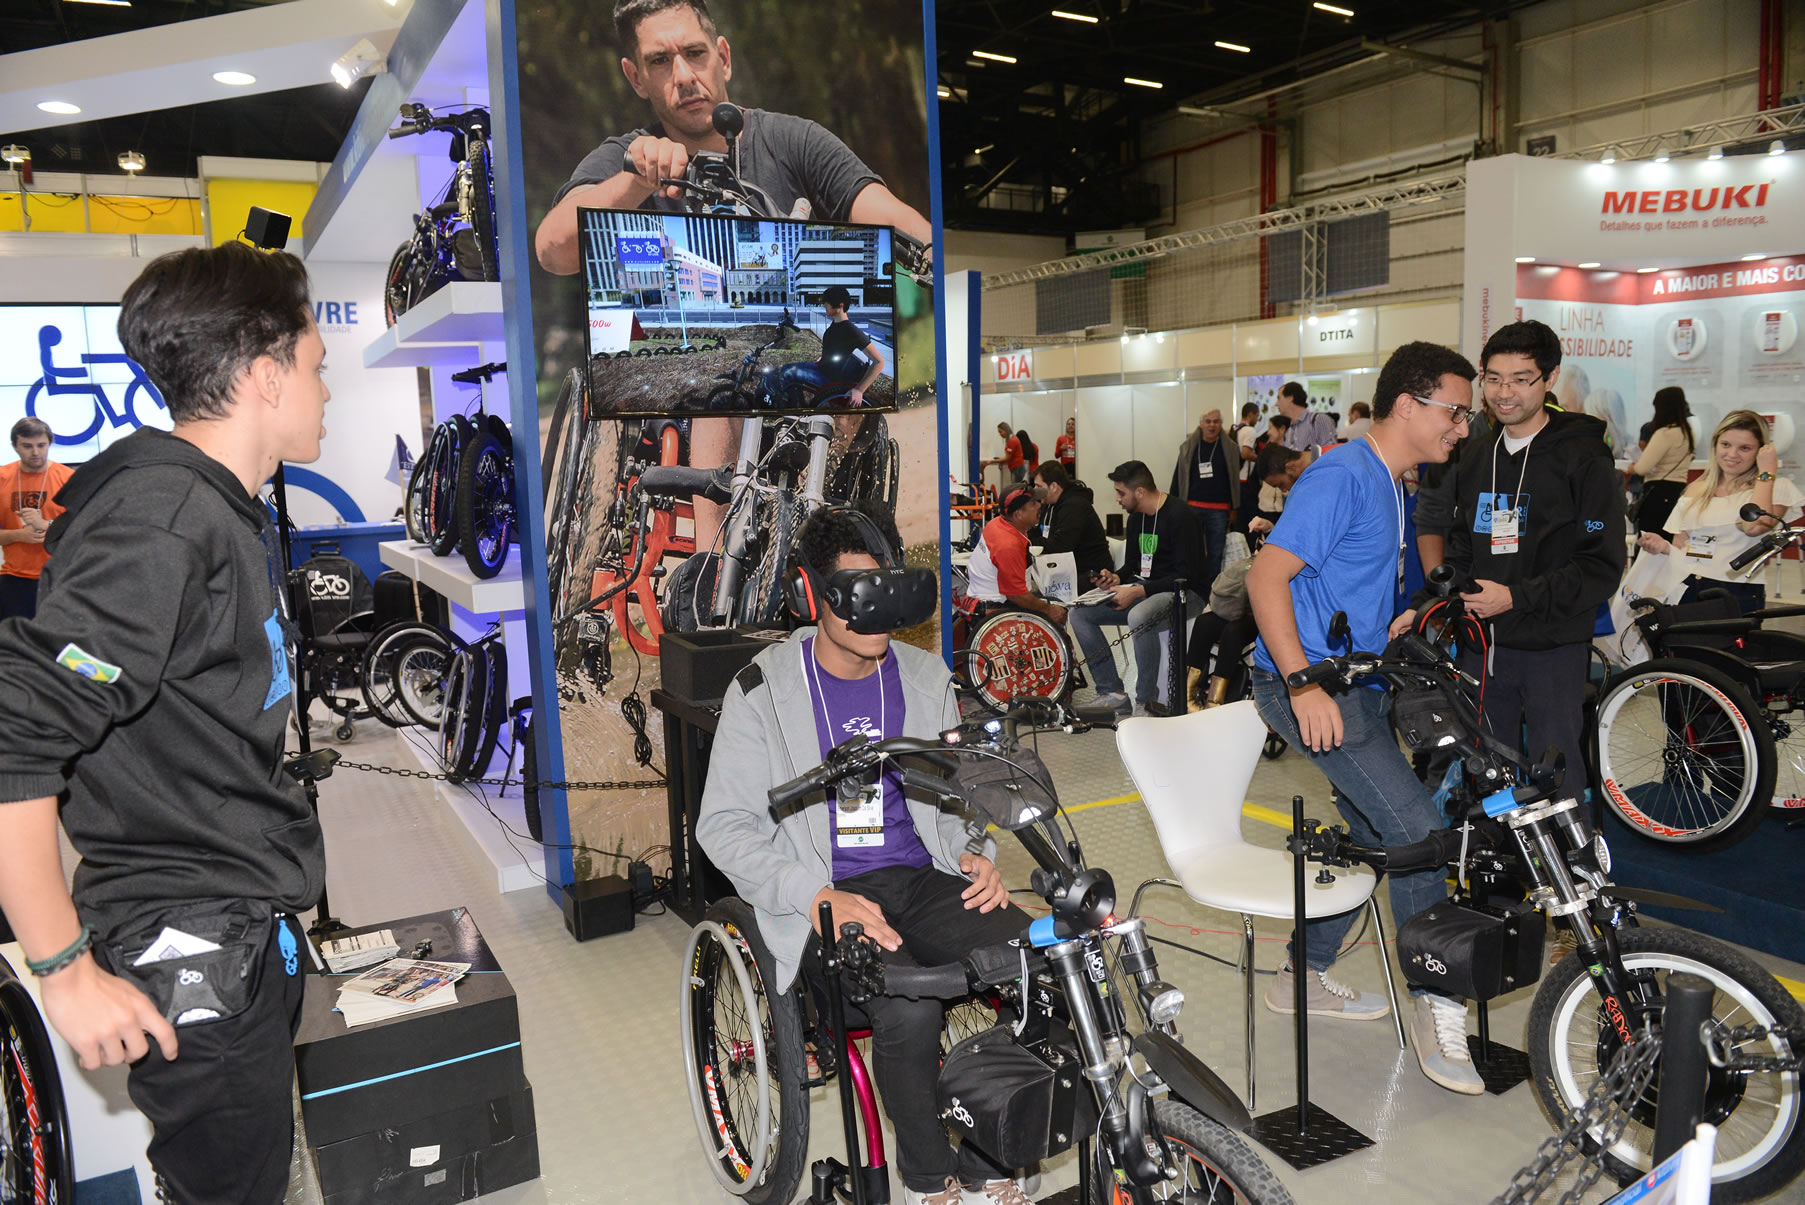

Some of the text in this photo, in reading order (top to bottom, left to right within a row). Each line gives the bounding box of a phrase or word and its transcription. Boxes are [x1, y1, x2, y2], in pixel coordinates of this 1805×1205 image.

[1601, 183, 1770, 214] MEBUKI
[1600, 214, 1769, 232] Detalhes que fazem a diferença.
[1653, 279, 1665, 295] A
[1667, 273, 1718, 293] MAIOR
[1722, 272, 1733, 288] E
[1736, 267, 1779, 286] MAIS
[1560, 306, 1606, 332] LINHA
[1320, 329, 1354, 342] DTITA
[692, 945, 701, 990] PRELLI
